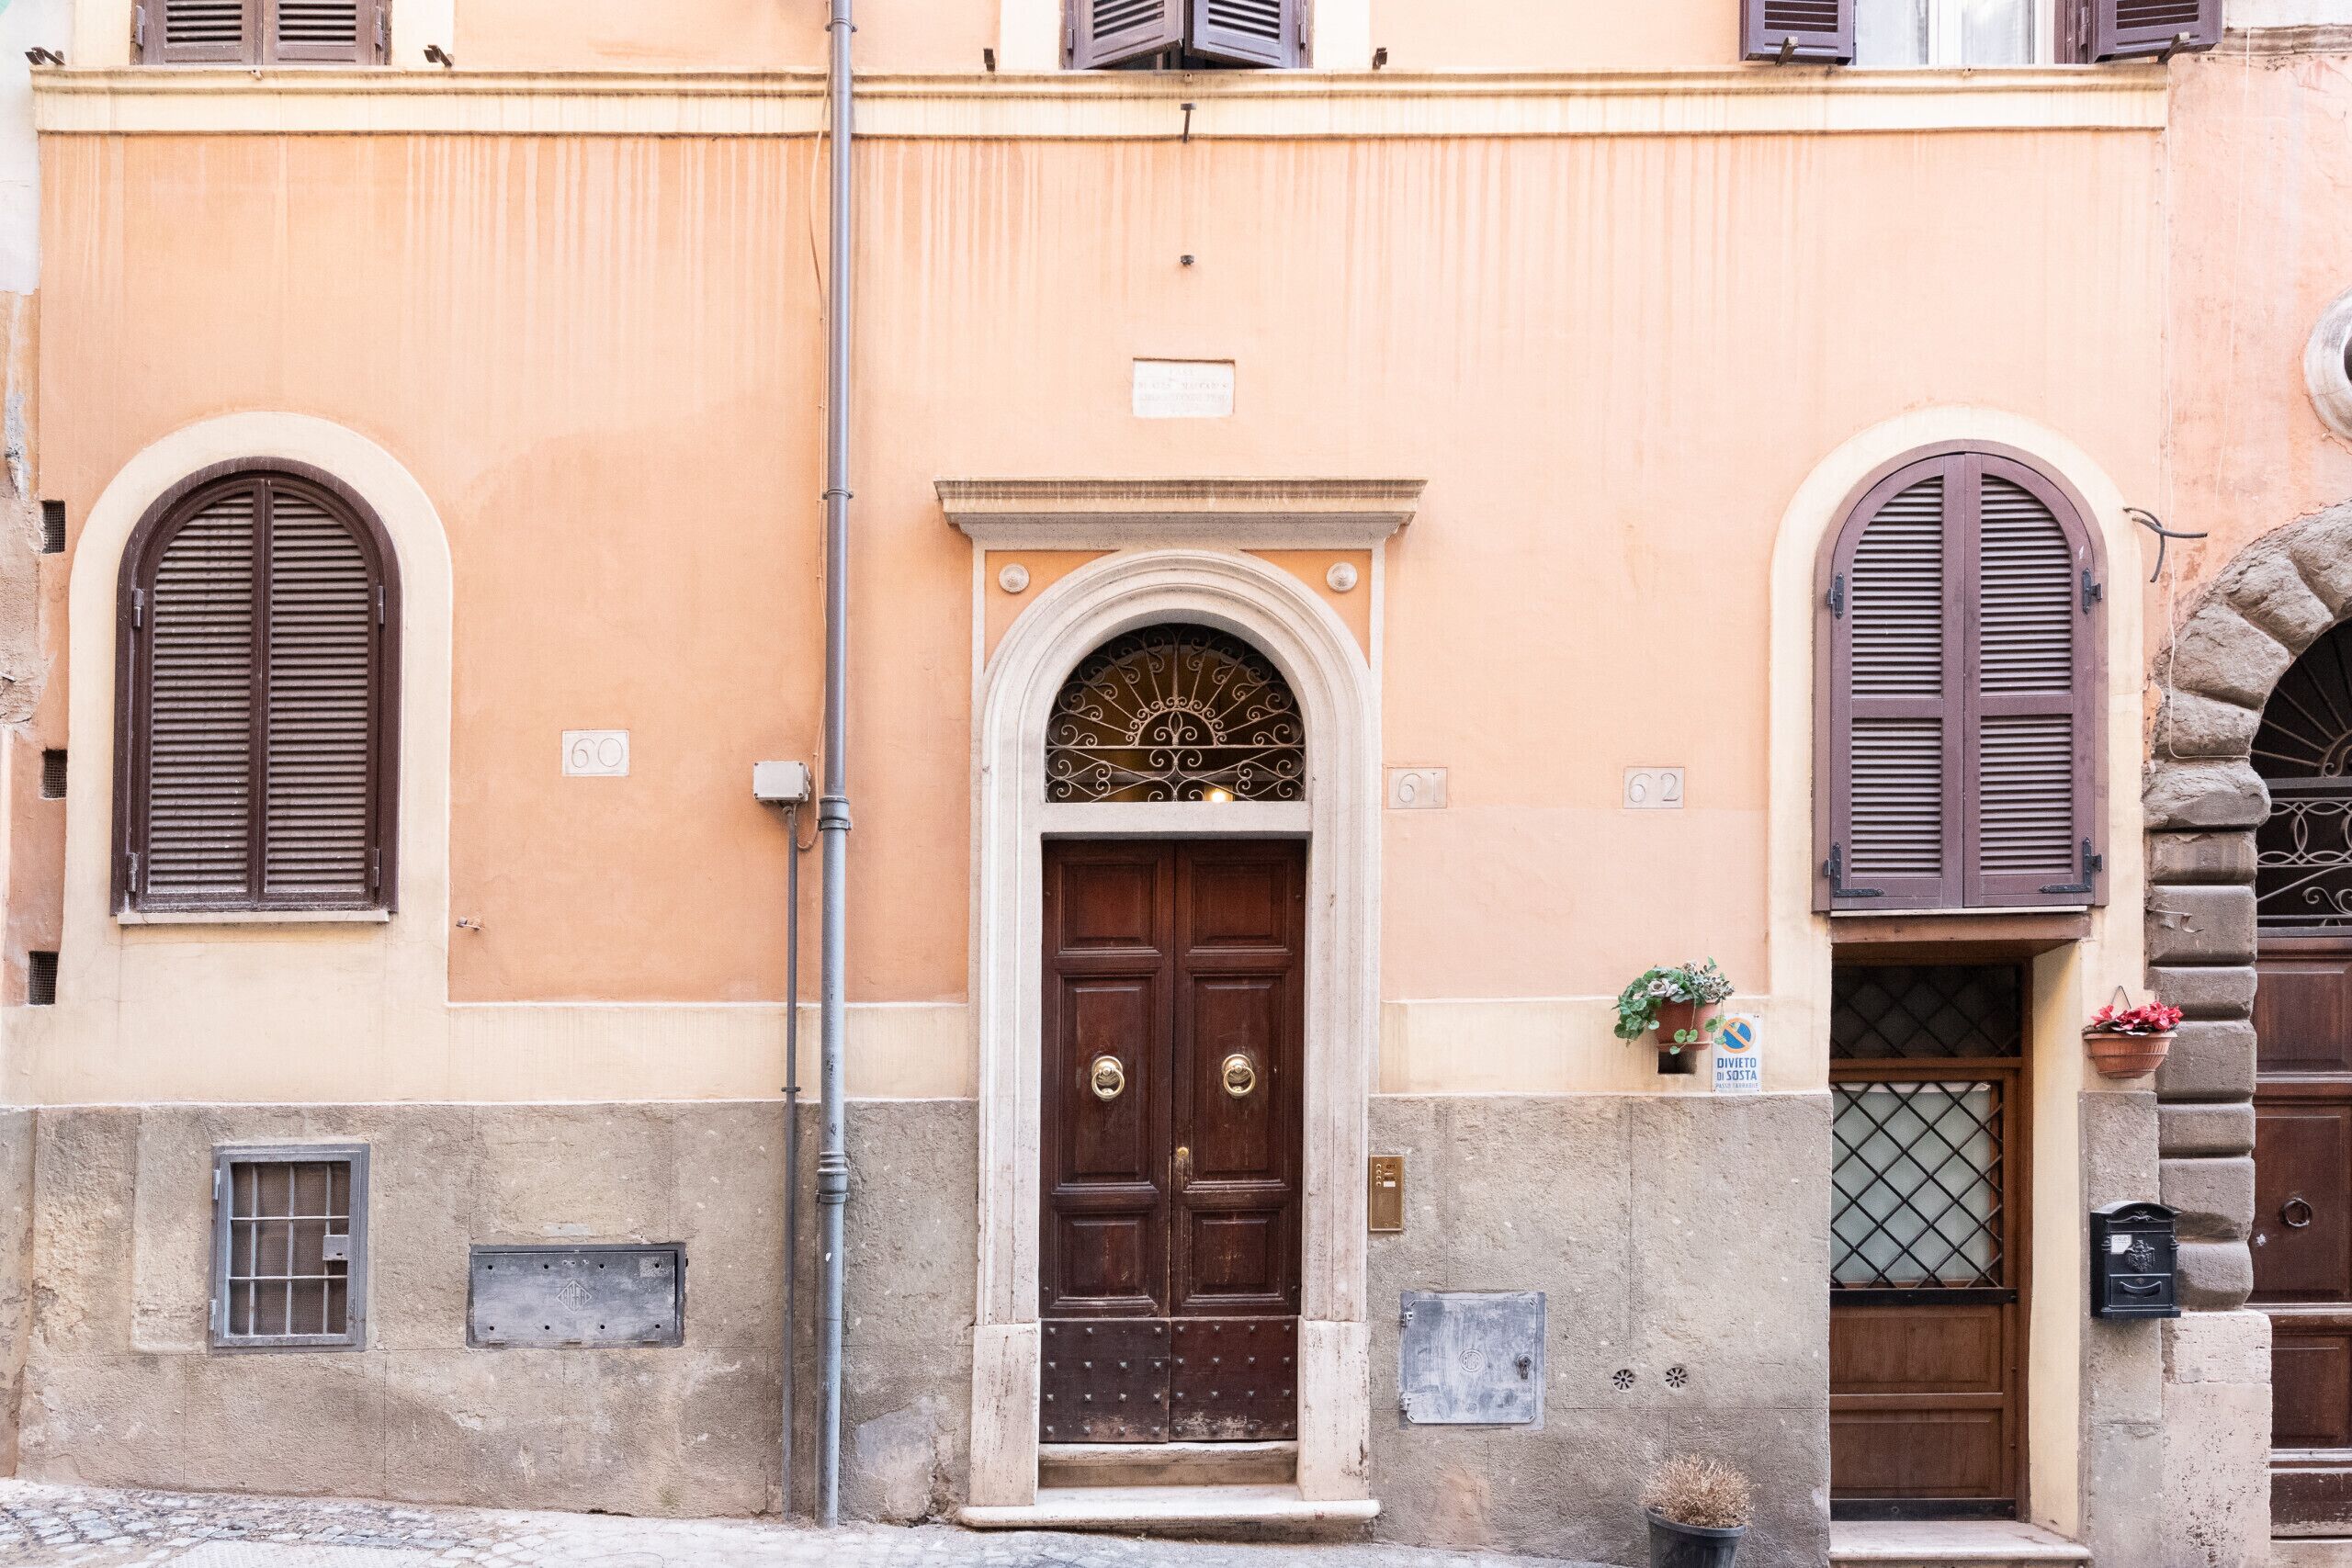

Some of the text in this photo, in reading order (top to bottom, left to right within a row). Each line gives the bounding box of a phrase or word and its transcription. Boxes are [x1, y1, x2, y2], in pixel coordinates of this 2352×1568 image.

[571, 738, 622, 768] 60
[1398, 773, 1437, 803] 61
[1629, 773, 1680, 803] 62
[1716, 1070, 1758, 1081] DI SOSTA
[1717, 1057, 1757, 1068] DIVIETO
